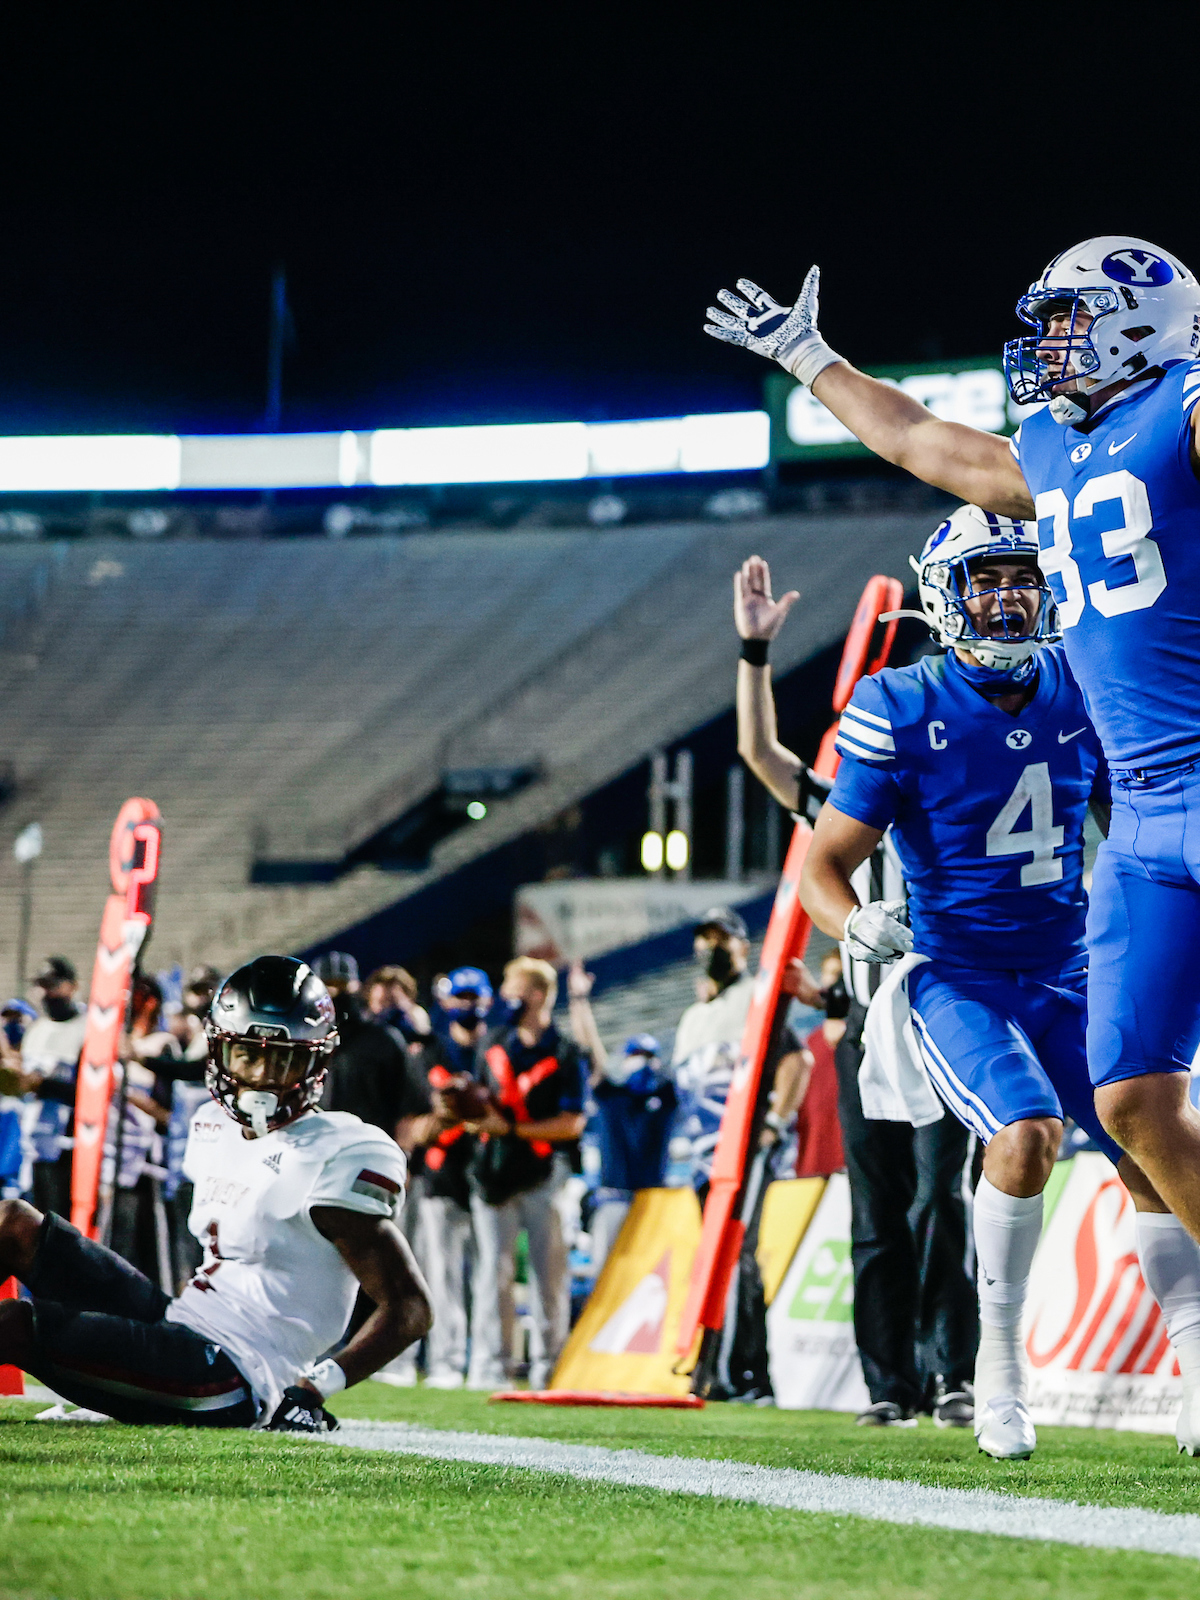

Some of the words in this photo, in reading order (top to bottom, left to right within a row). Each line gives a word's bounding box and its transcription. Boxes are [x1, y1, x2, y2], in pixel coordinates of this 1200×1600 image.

[1036, 469, 1167, 630] 83
[927, 720, 948, 750] C
[986, 761, 1064, 887] 4
